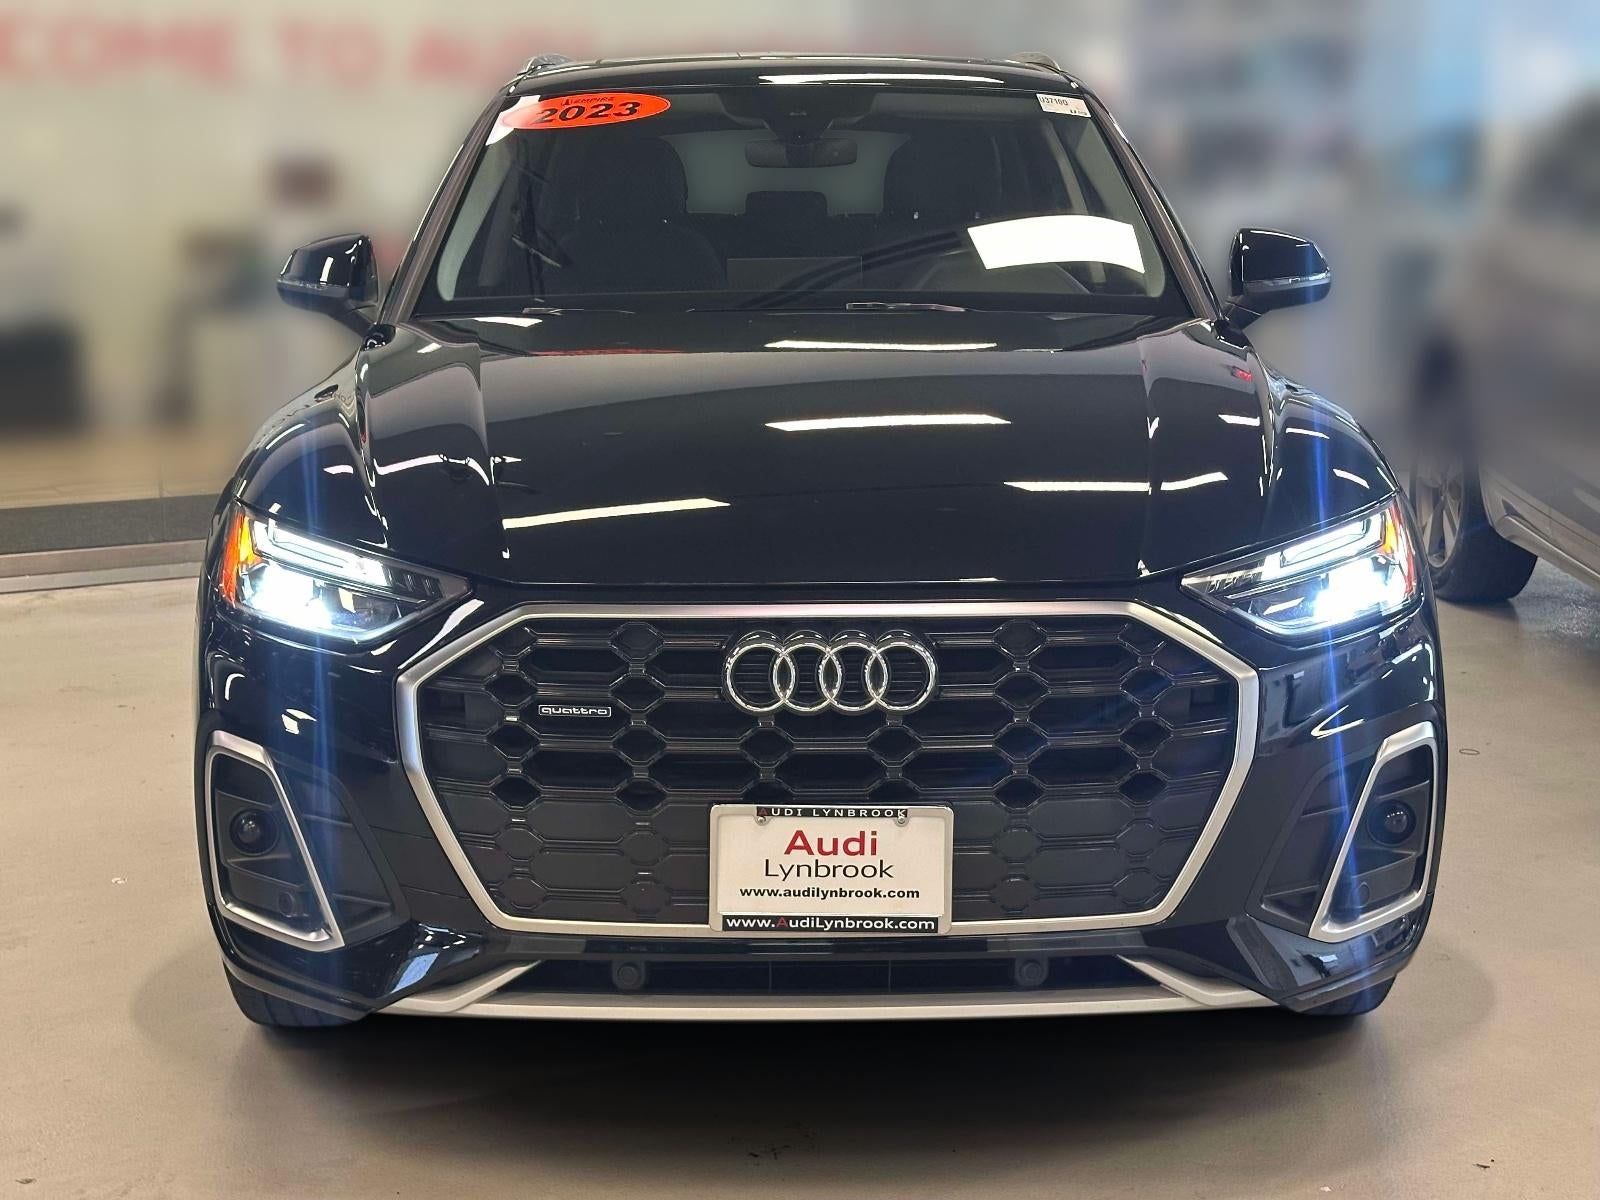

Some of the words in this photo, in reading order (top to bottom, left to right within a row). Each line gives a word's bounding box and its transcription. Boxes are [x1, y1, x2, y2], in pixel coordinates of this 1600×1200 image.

[532, 102, 641, 124] 2023
[541, 707, 607, 715] quattro
[758, 807, 803, 817] AUDI
[812, 807, 908, 818] LYNBROOK
[783, 829, 878, 856] Audi
[764, 858, 895, 882] Lynbrook
[739, 887, 920, 901] www.audilynbrook.com
[726, 917, 936, 931] www.AudiLynbrook.com
